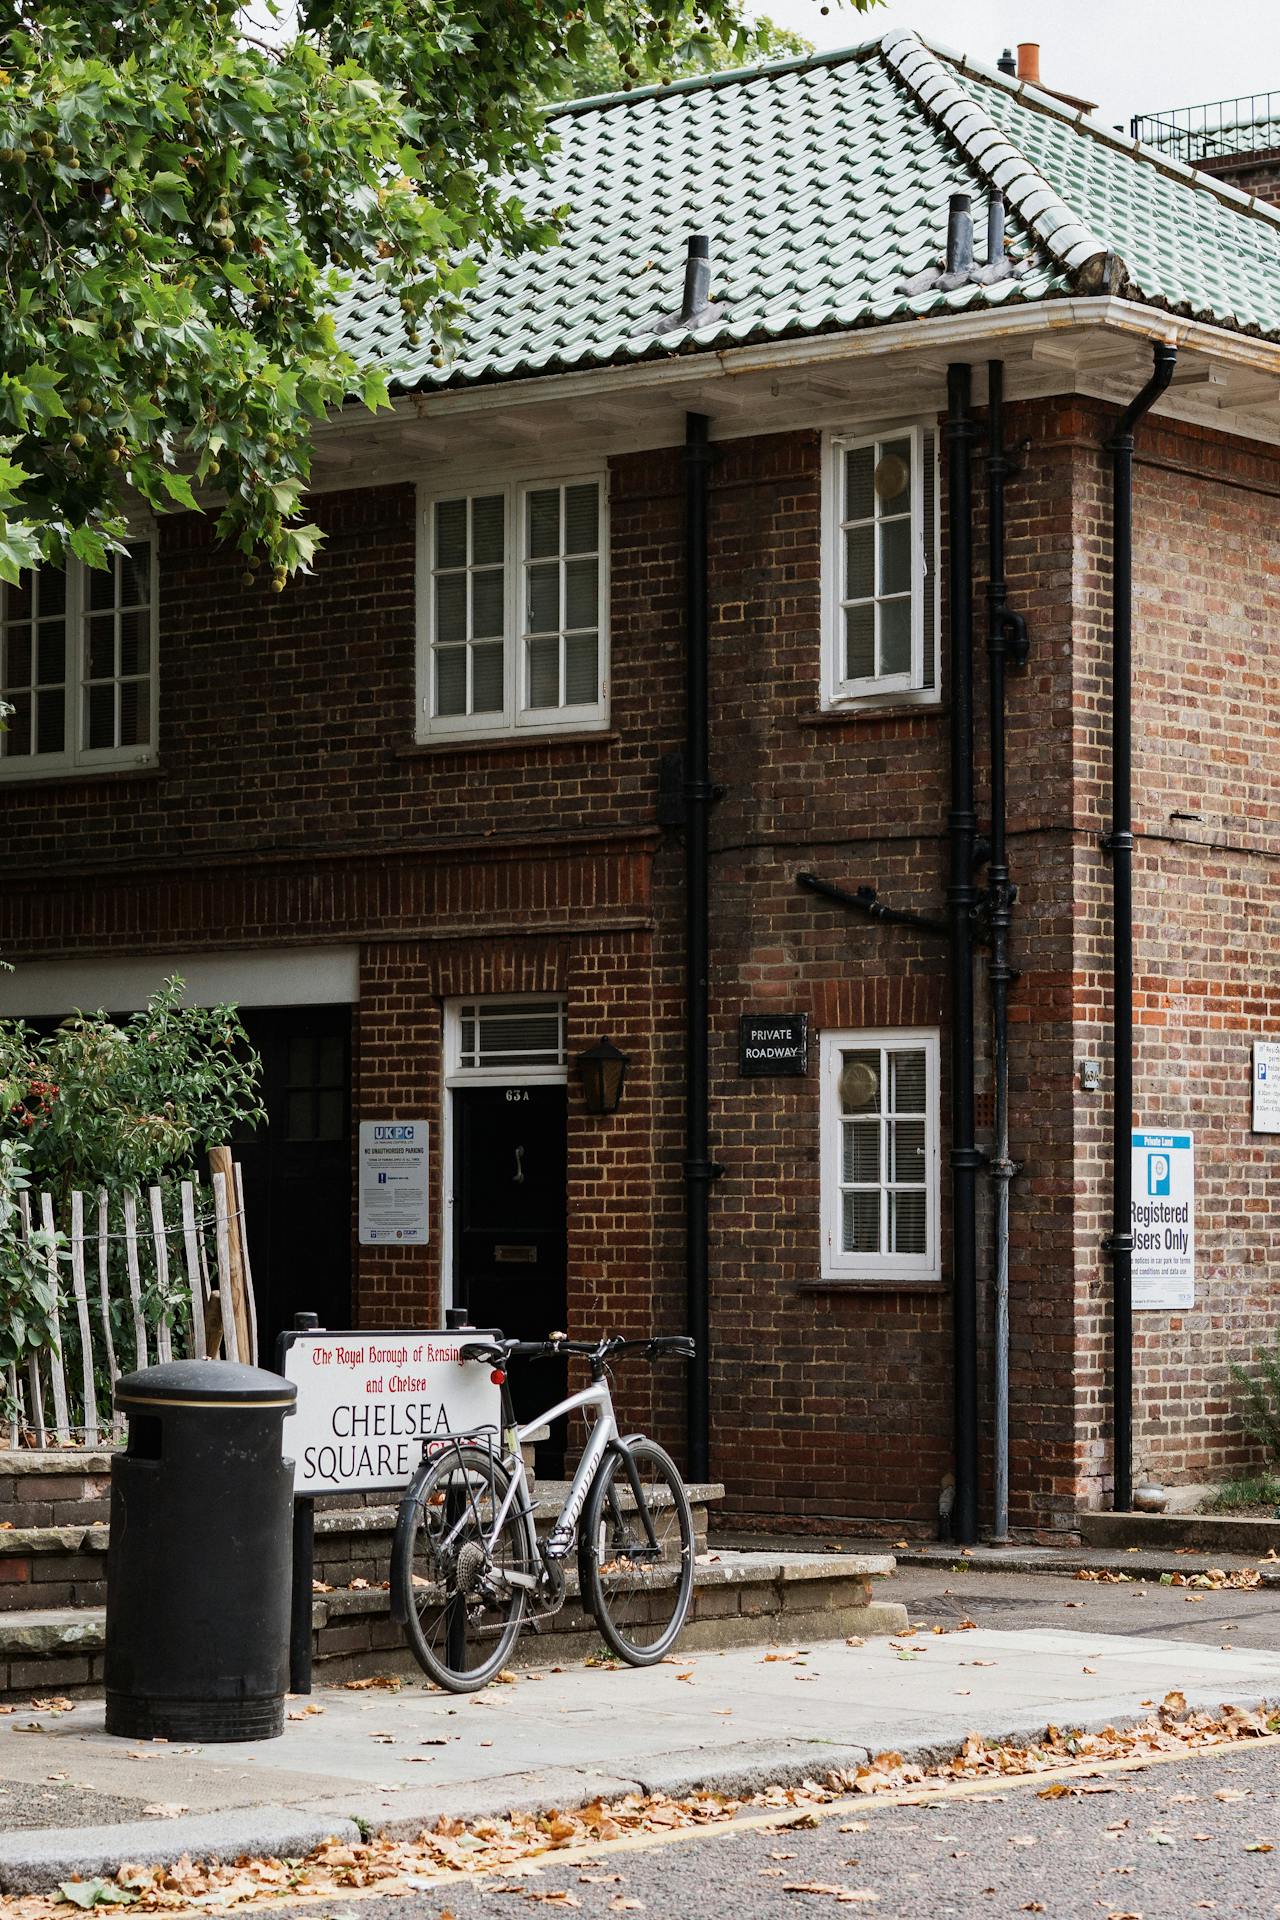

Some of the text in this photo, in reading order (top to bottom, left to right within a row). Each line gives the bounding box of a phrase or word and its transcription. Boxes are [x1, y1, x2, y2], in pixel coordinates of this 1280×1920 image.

[751, 1029, 792, 1040] PRIVATE
[745, 1047, 798, 1059] ROADWAY
[505, 1089, 530, 1101] 63A
[375, 1127, 414, 1139] UKPC
[1143, 1136, 1173, 1147] Private Land
[1131, 1201, 1188, 1228] Registered
[1164, 1228, 1189, 1255] Only
[312, 1343, 465, 1369] The Royal Borough of Kensing
[366, 1375, 427, 1393] and Chelsea
[331, 1403, 451, 1437] CHELSEA
